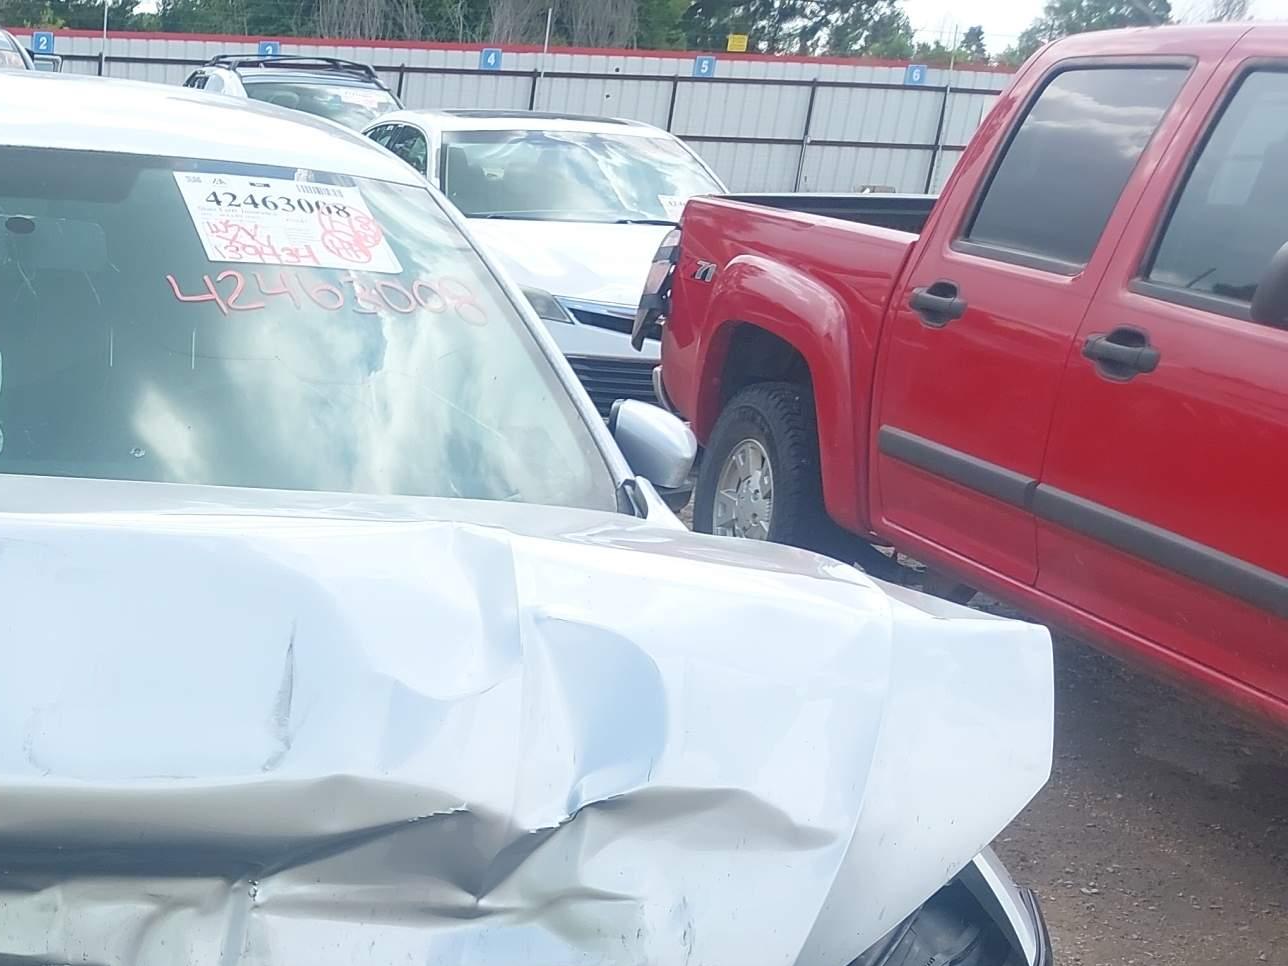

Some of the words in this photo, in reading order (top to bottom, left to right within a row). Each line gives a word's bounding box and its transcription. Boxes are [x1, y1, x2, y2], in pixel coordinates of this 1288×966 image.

[39, 36, 48, 50] 2
[487, 52, 496, 66] 4
[701, 60, 709, 73] 5
[912, 69, 921, 82] 6
[205, 191, 351, 218] 42463008
